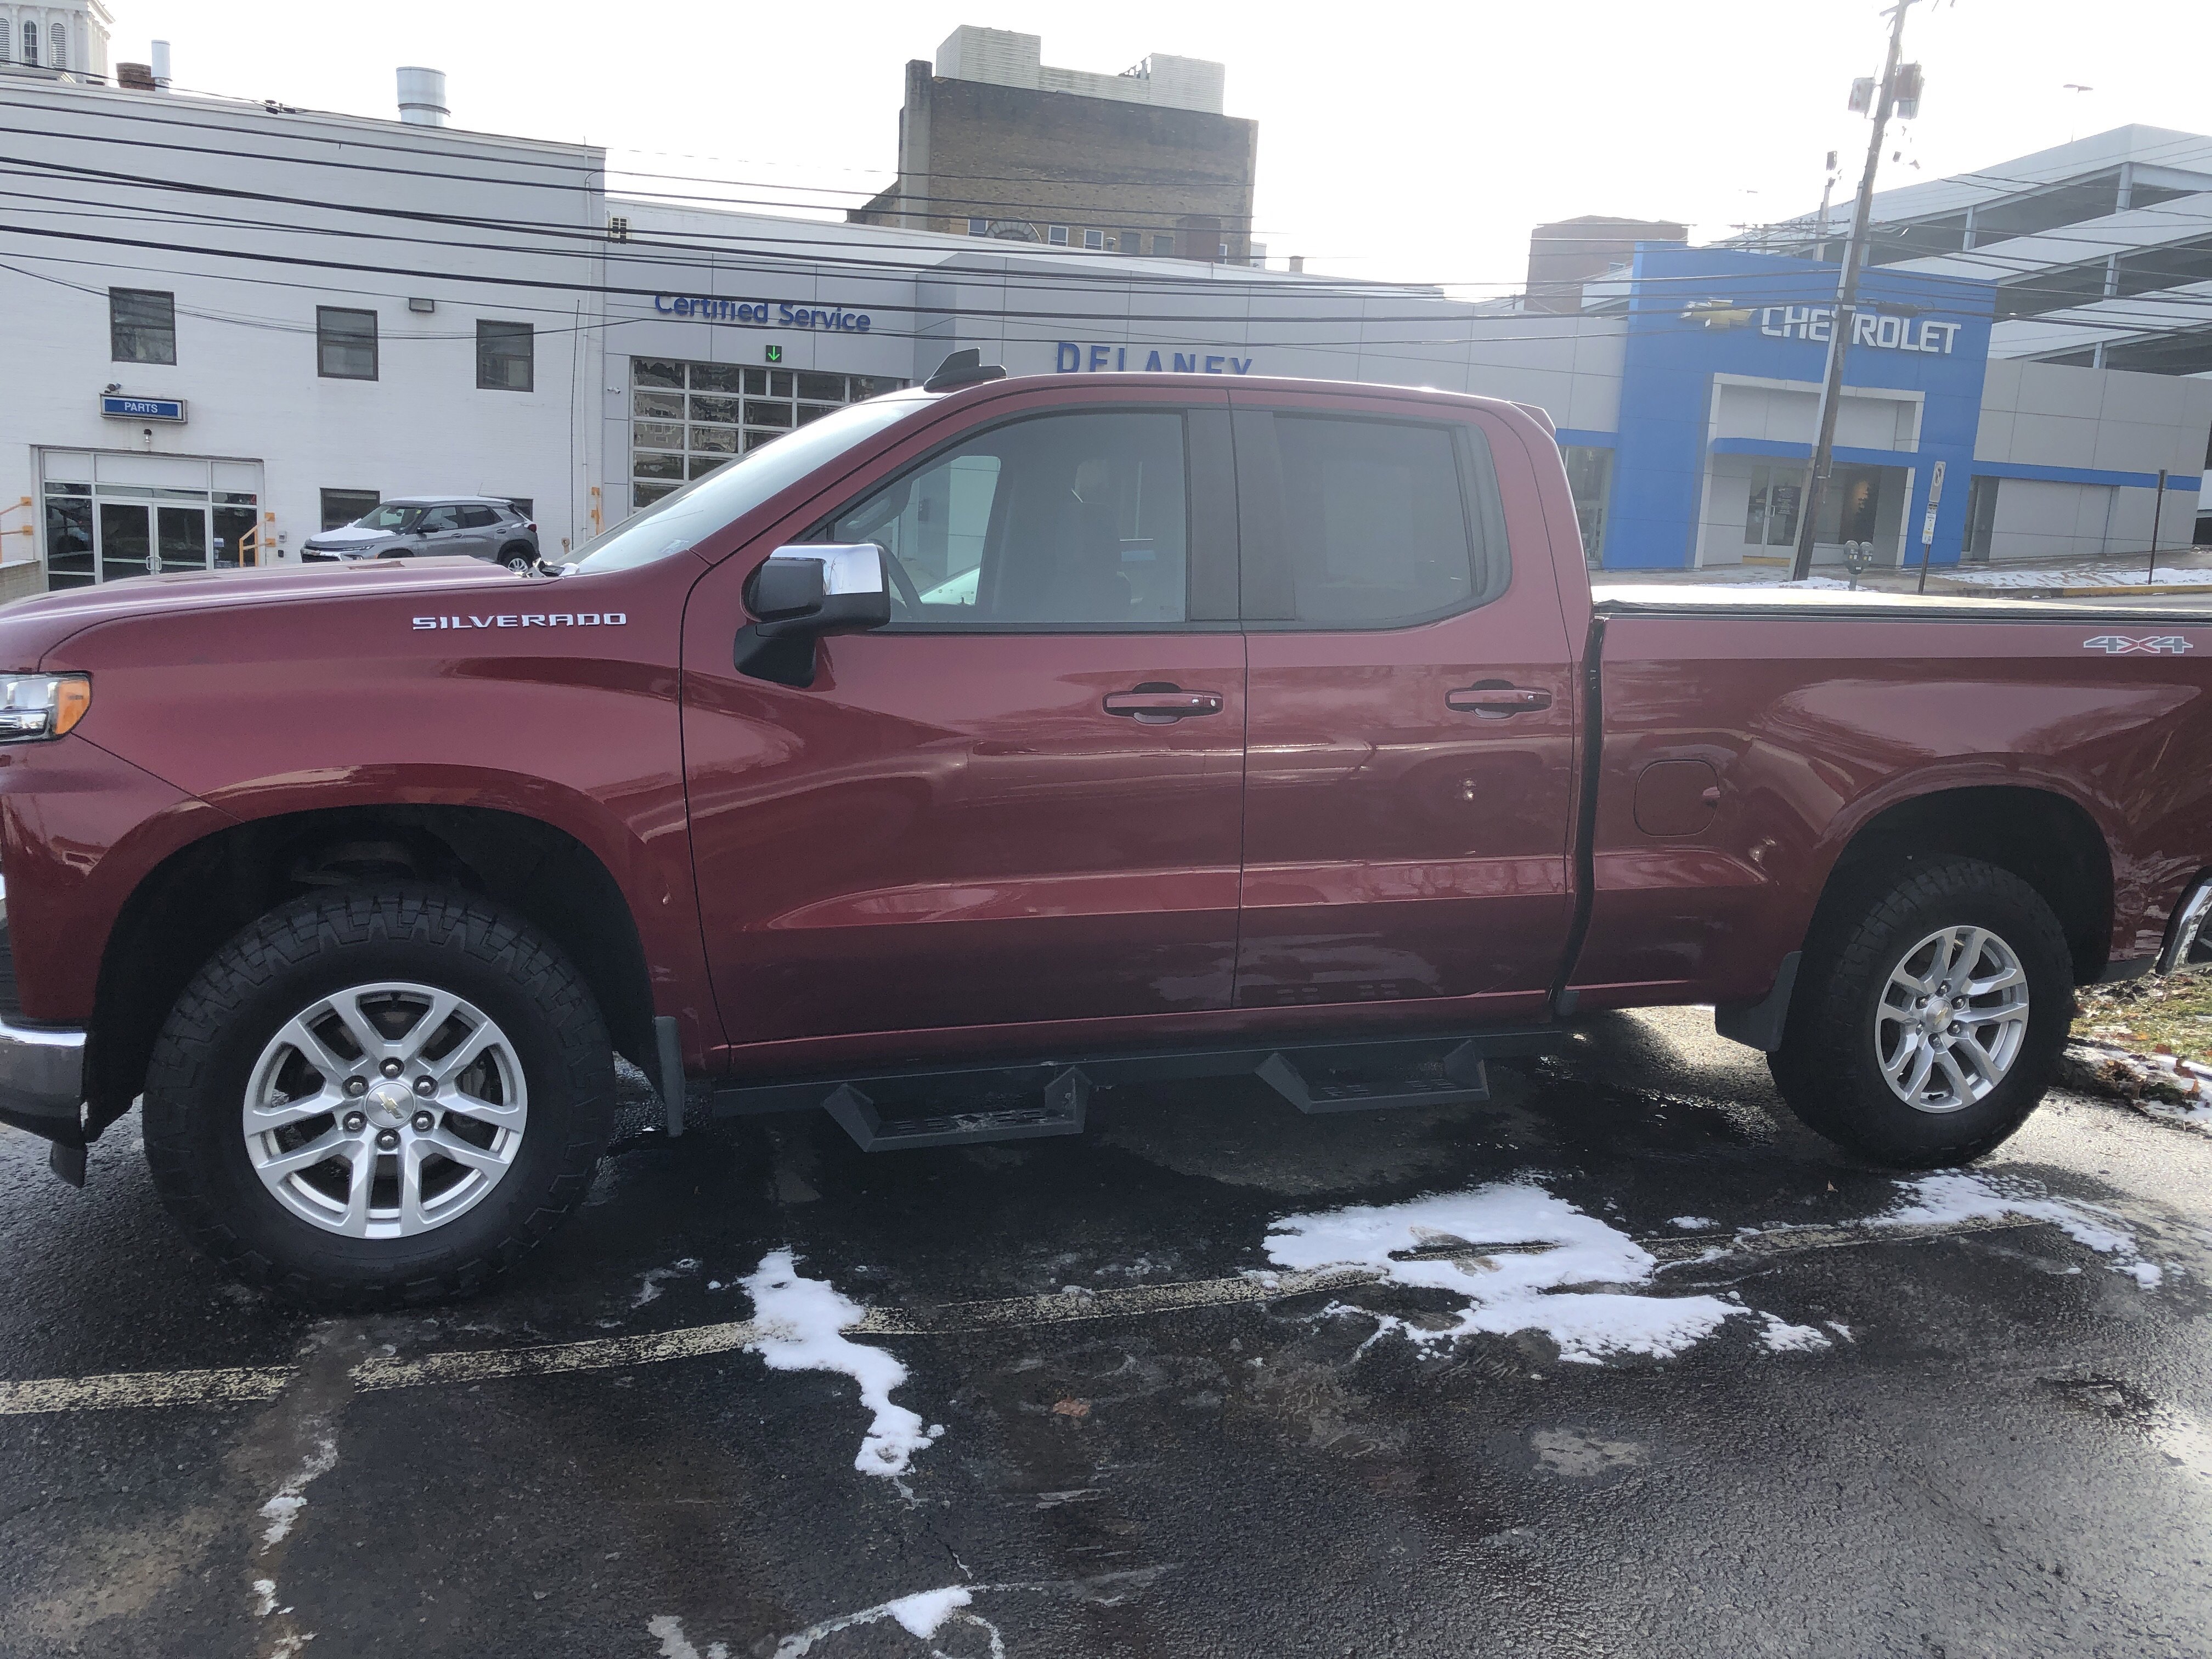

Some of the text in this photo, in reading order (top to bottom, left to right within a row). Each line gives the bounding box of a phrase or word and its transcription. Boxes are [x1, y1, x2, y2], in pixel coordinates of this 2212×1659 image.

[655, 294, 871, 331] Certified Service
[1761, 306, 1962, 354] CHEROLET
[124, 402, 158, 413] PARTS
[413, 612, 627, 630] SILVERADO
